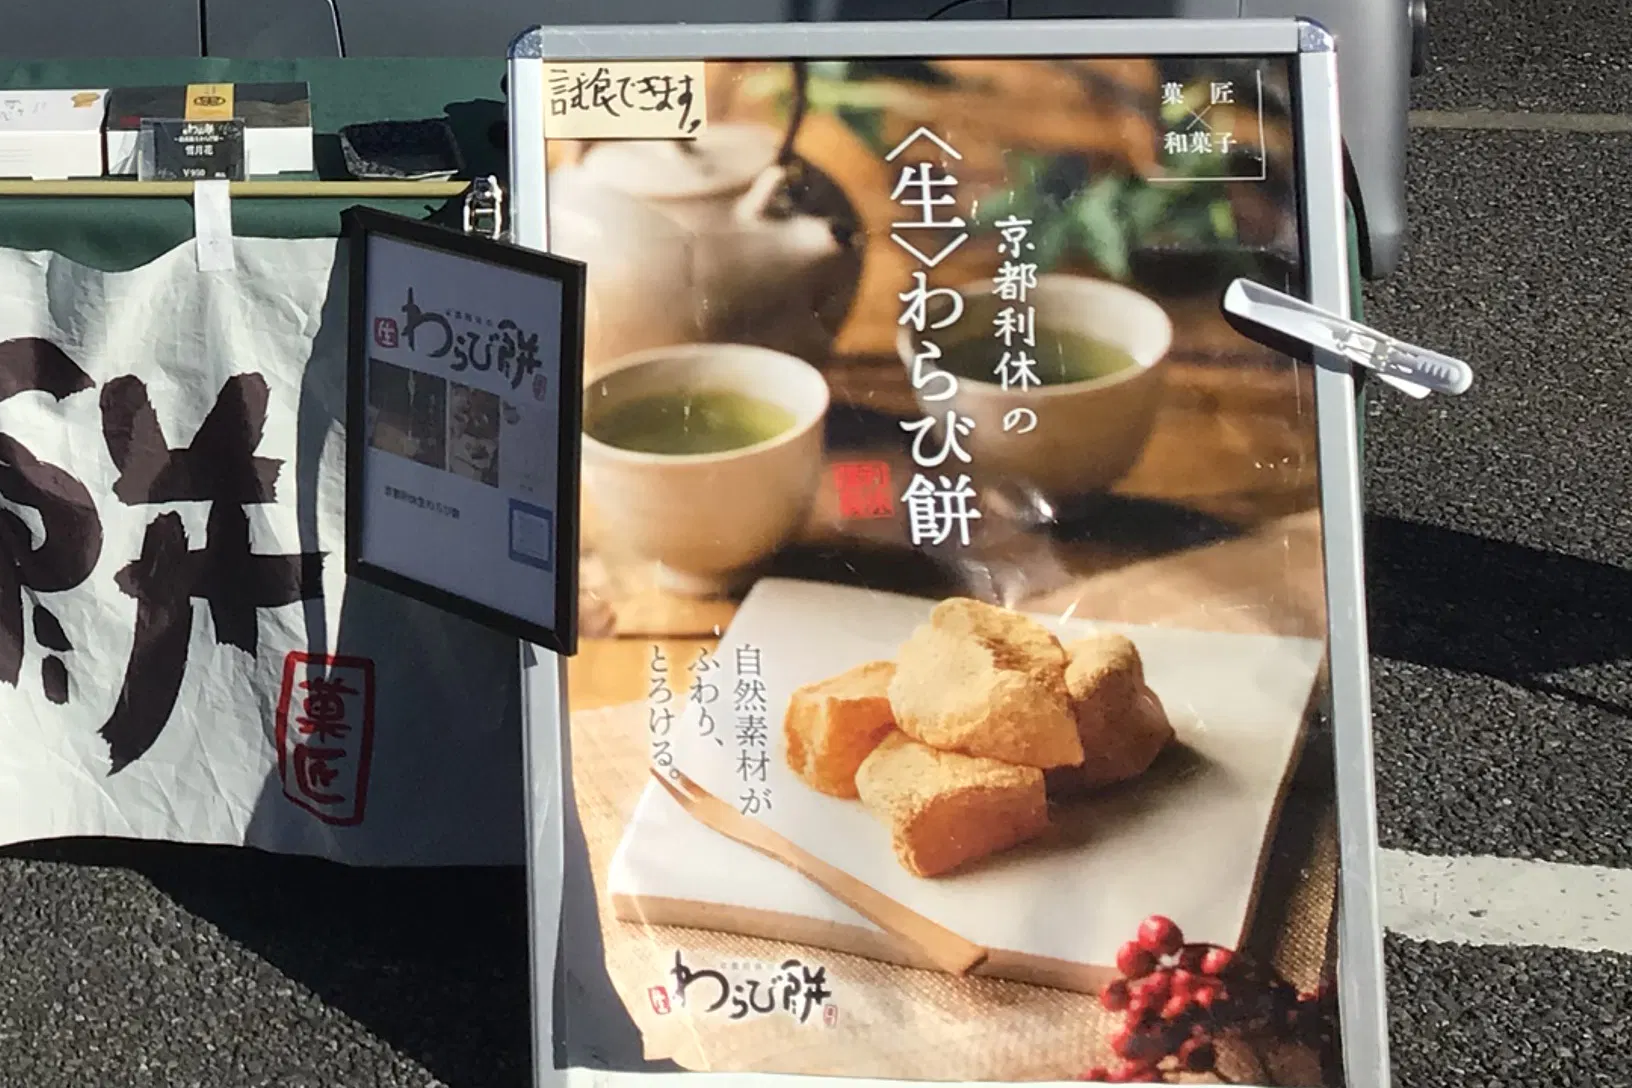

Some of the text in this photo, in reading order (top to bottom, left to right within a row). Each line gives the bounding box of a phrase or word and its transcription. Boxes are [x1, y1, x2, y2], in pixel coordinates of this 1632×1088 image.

[1164, 131, 1237, 155] 和菓子
[401, 286, 543, 389] わらび餅
[992, 214, 1042, 436] 京都利休の
[648, 645, 680, 779] とろける。
[687, 647, 724, 746] ふわり、
[733, 644, 772, 815] 自然素材が
